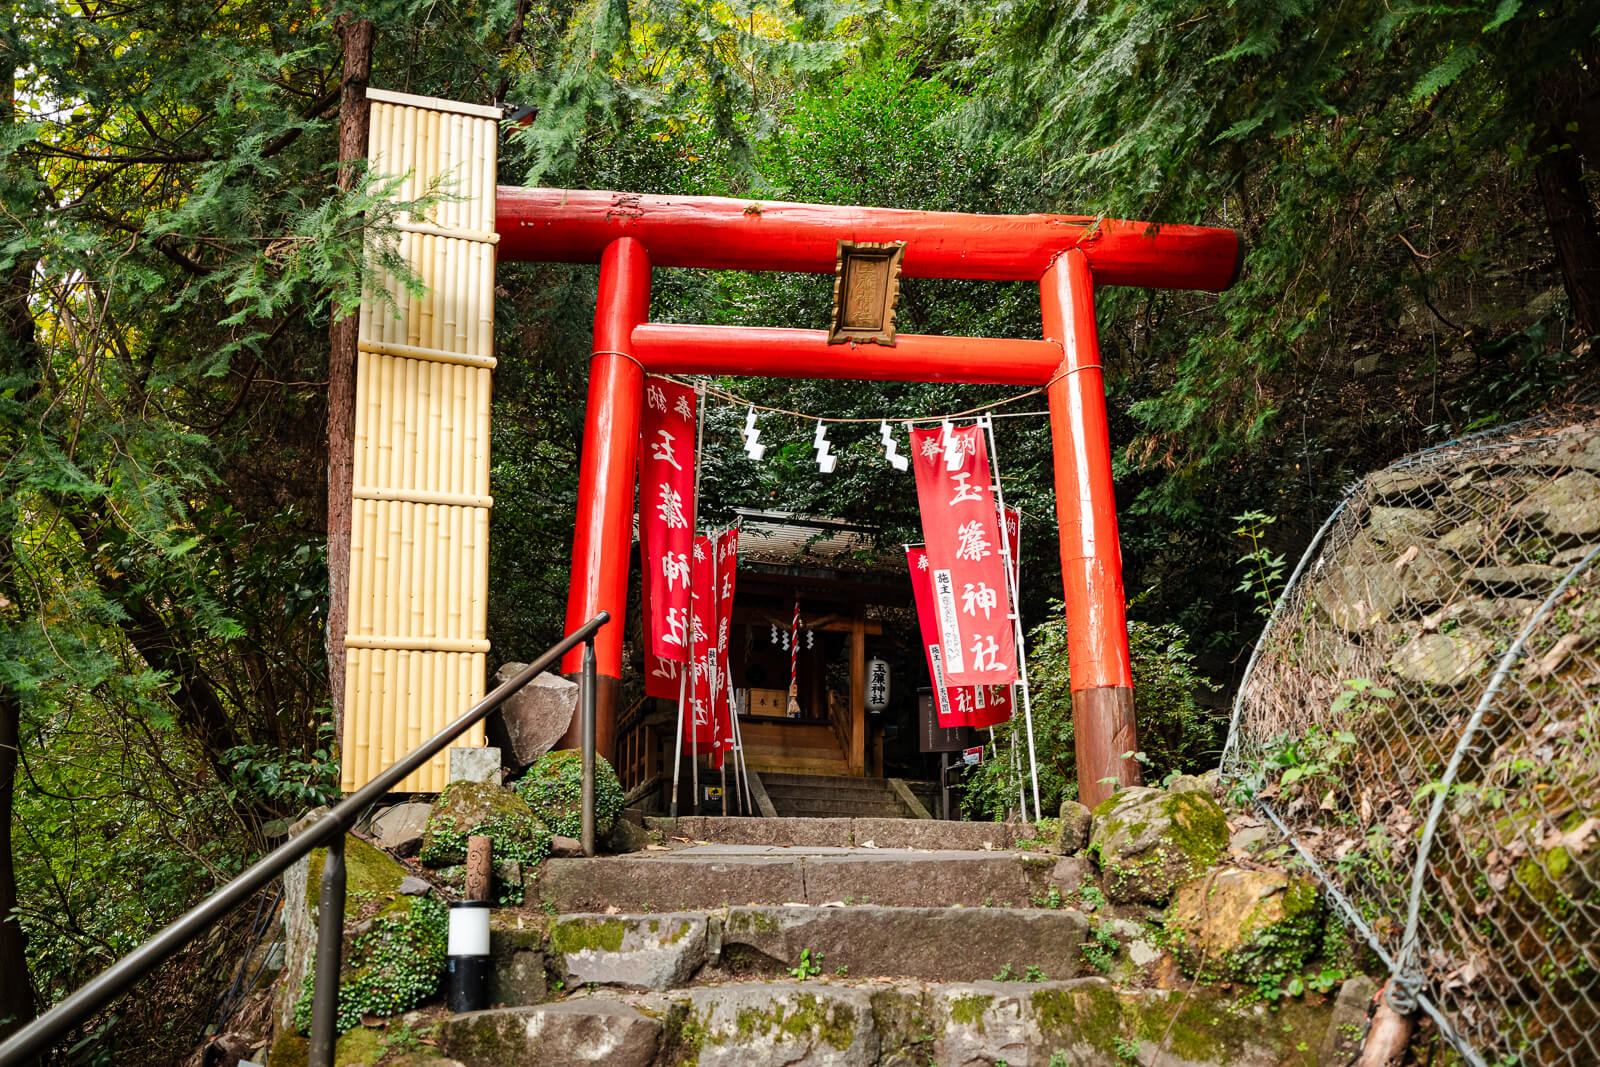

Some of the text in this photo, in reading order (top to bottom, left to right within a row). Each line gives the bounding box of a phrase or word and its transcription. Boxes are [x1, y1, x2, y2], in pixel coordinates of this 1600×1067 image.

[920, 434, 976, 461] 奉納
[937, 572, 951, 595] 施主
[949, 471, 1008, 673] 玉簾神社
[871, 663, 887, 705] 玉簾神社
